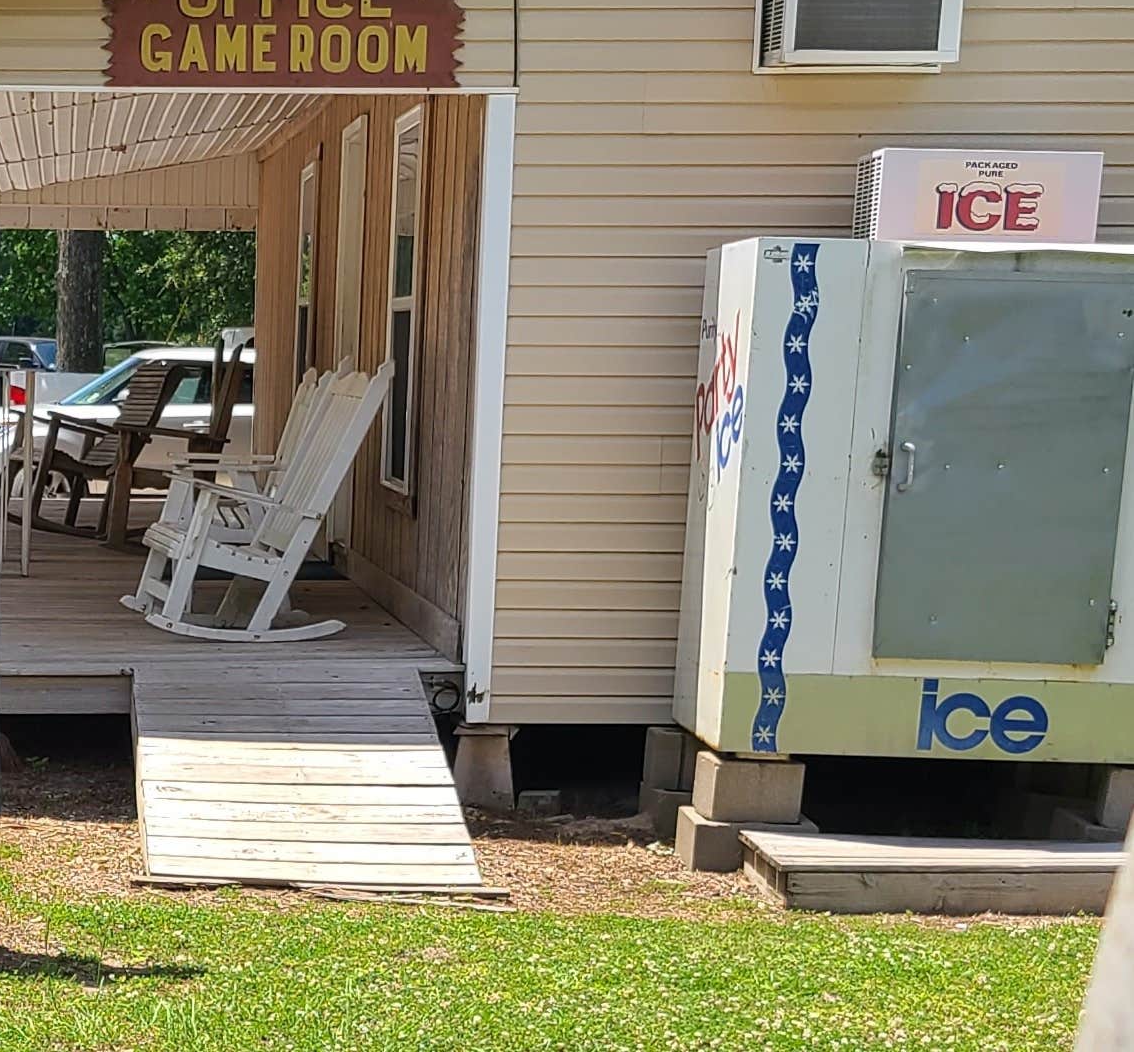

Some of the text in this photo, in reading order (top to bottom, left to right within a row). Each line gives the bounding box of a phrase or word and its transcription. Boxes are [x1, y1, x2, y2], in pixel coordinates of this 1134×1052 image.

[140, 23, 428, 74] GAME ROOM
[966, 161, 1018, 170] PACKAGED
[979, 170, 1003, 178] PURE
[936, 181, 1044, 231] ICE
[917, 678, 1048, 754] ice
